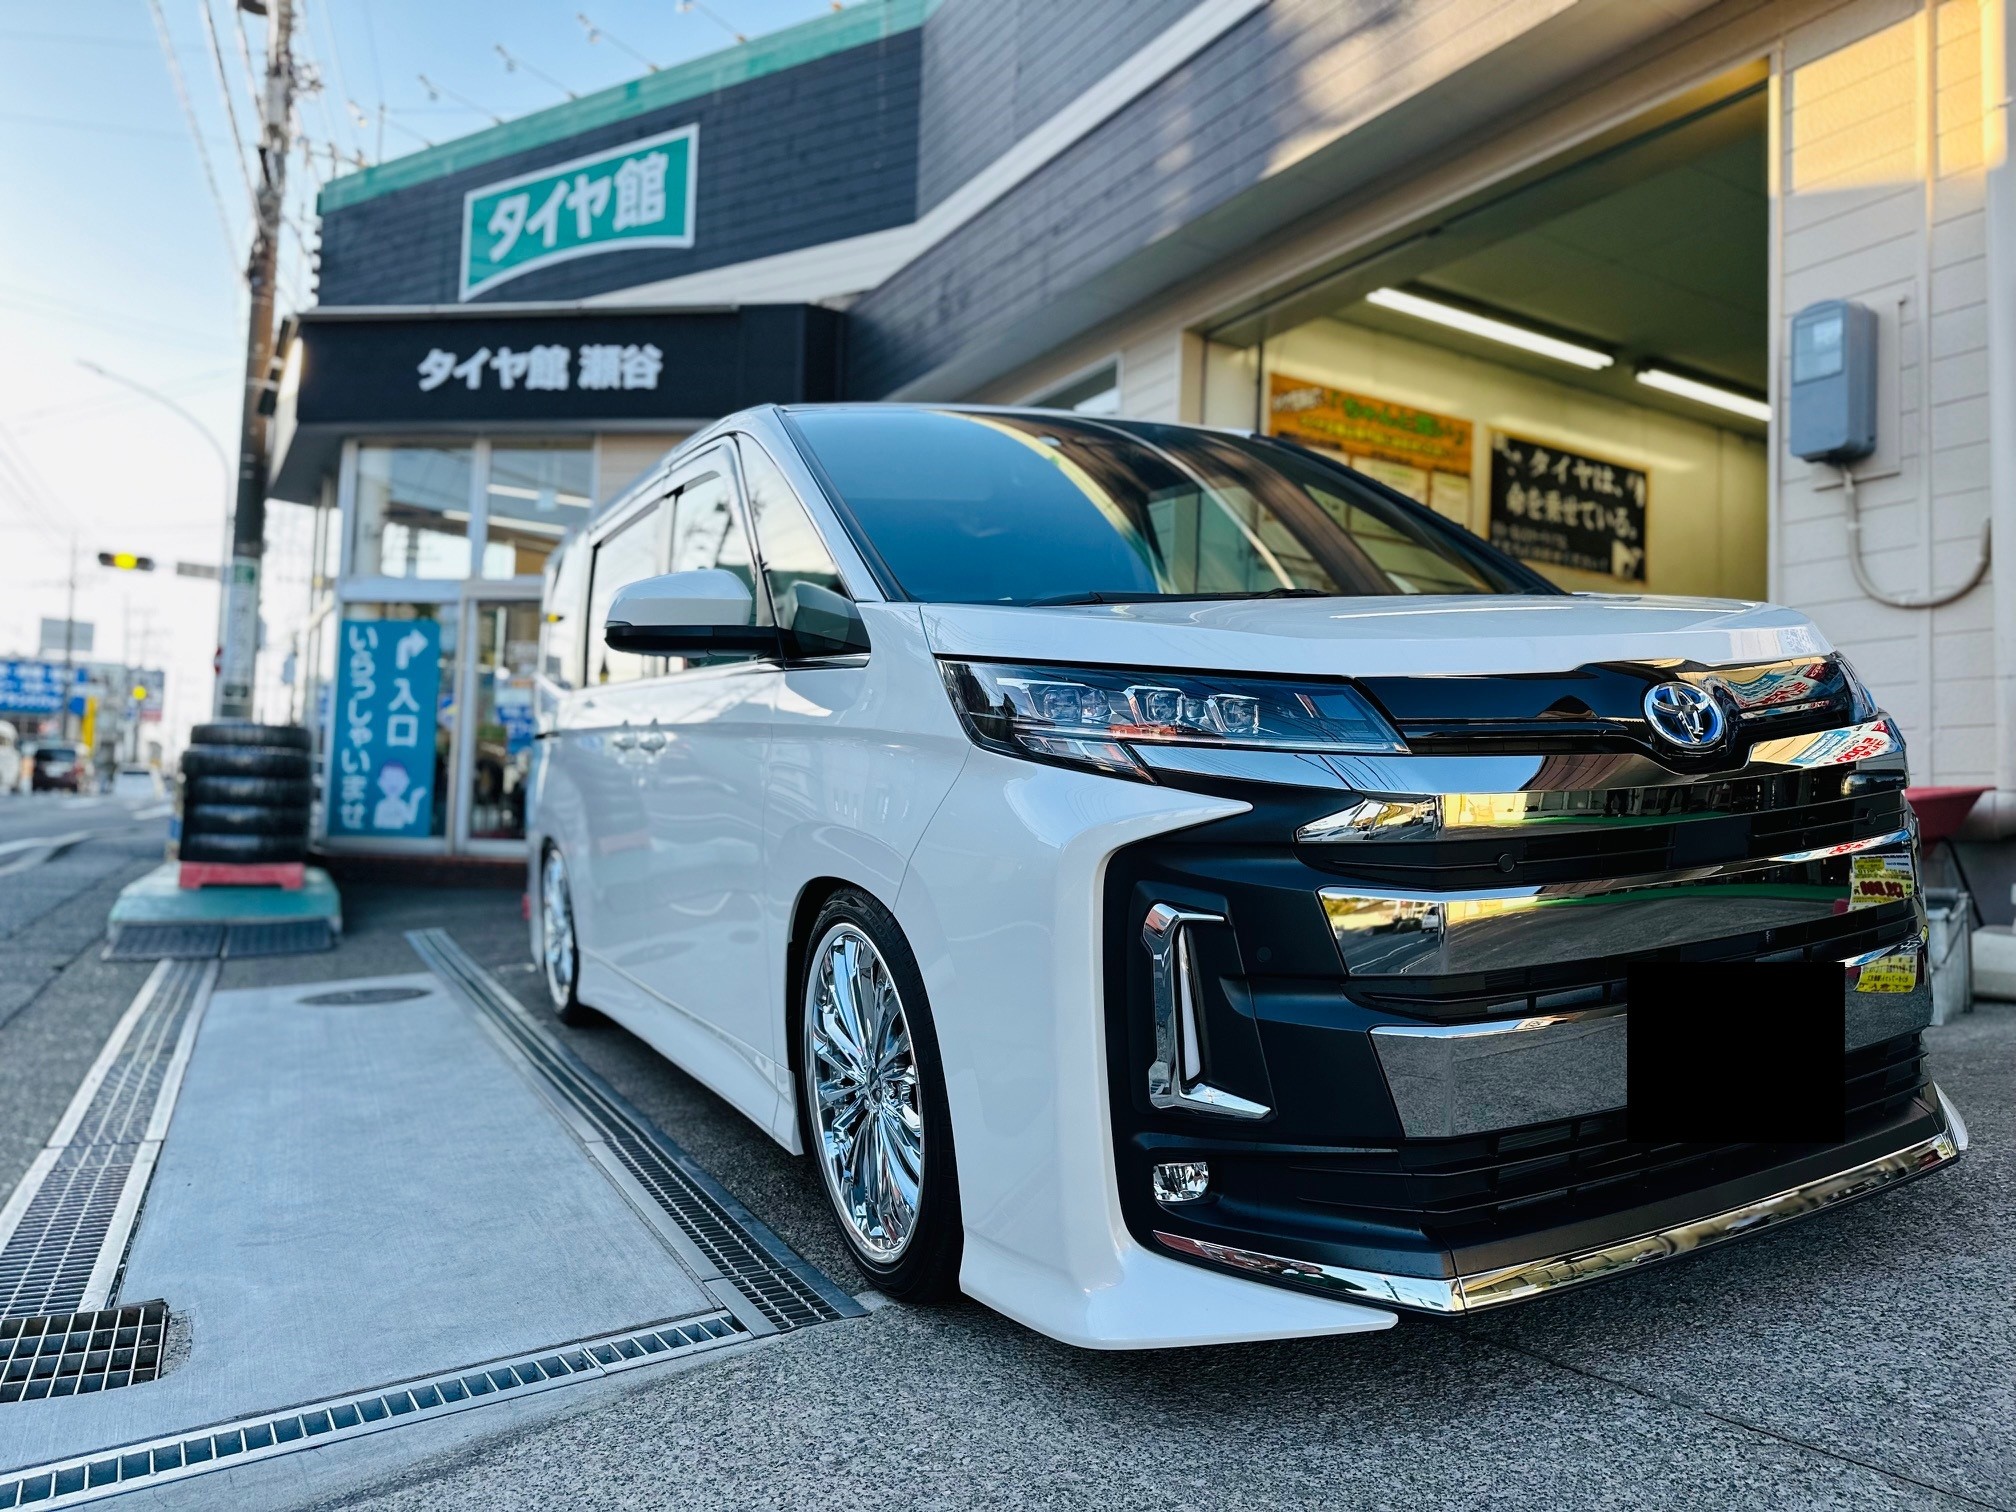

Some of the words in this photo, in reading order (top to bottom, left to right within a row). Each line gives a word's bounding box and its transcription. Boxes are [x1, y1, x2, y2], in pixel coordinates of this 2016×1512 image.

[487, 151, 669, 263] タイヤ館
[417, 345, 570, 391] タイヤ館
[578, 344, 663, 390] 瀬谷
[340, 625, 379, 829] いらっしゃいませ
[386, 677, 421, 747] 入口
